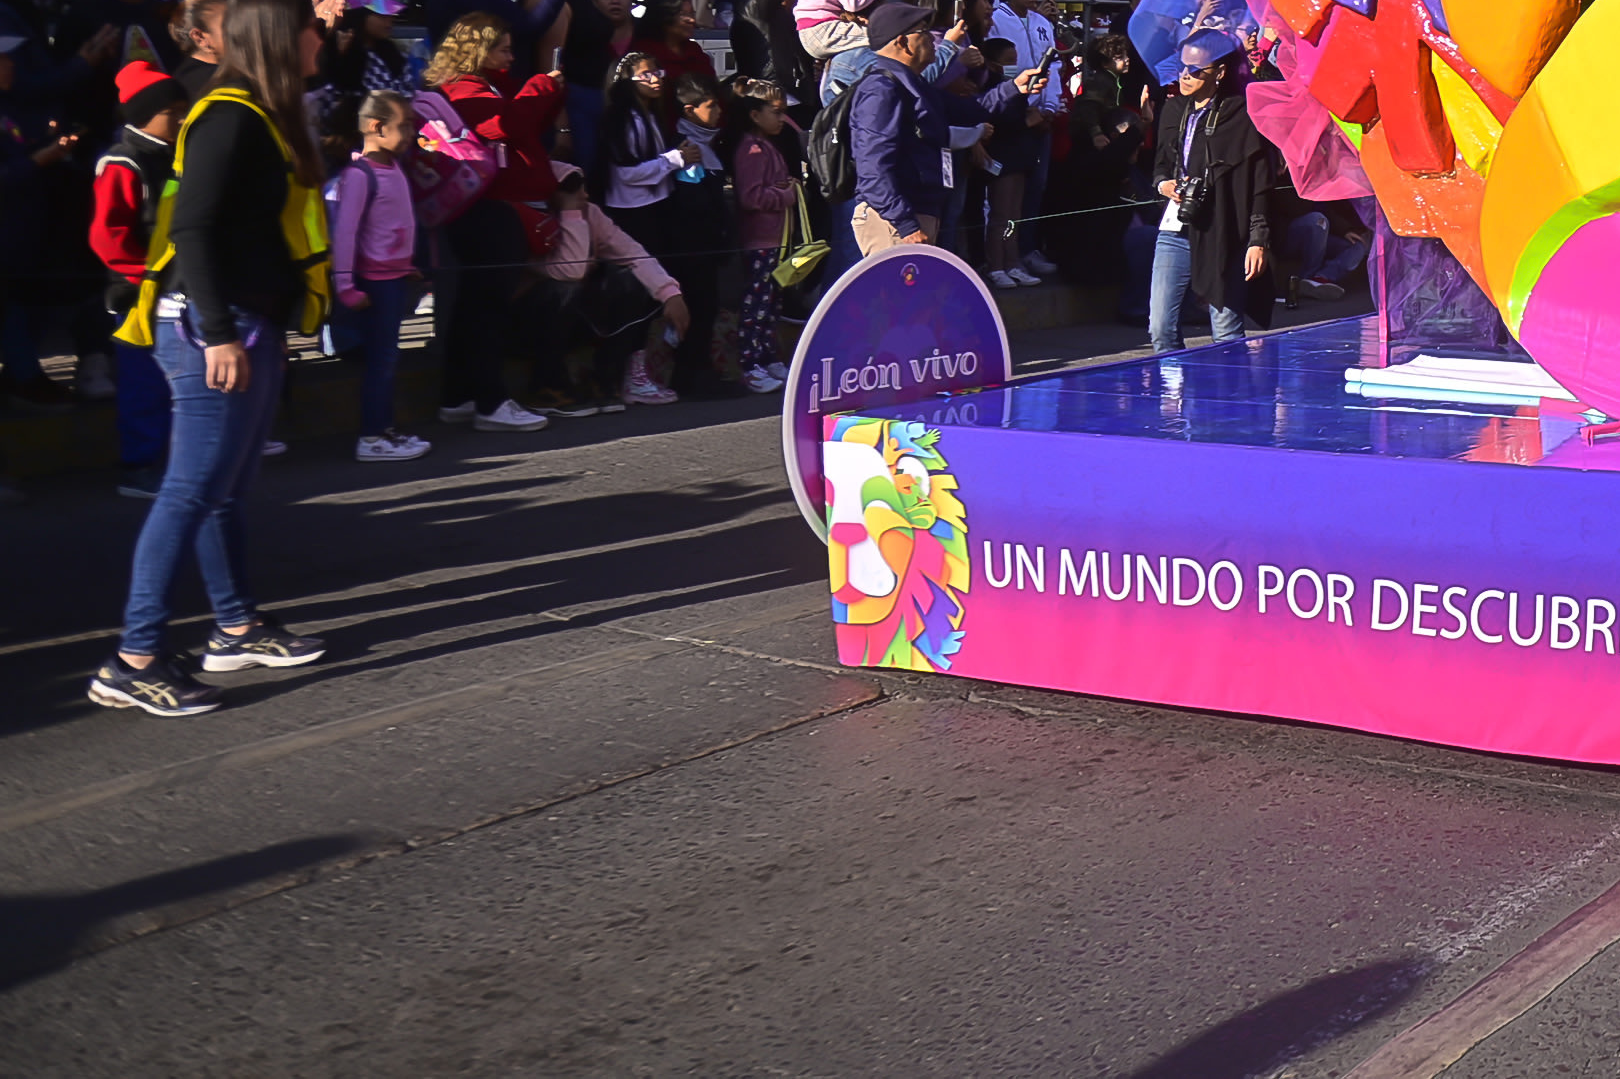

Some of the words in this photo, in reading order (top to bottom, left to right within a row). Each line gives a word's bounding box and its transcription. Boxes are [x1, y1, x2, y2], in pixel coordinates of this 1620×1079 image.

[909, 348, 977, 383] vivo
[982, 539, 1045, 593] UN
[1057, 548, 1243, 612] MUNDO
[1257, 564, 1355, 628] POR
